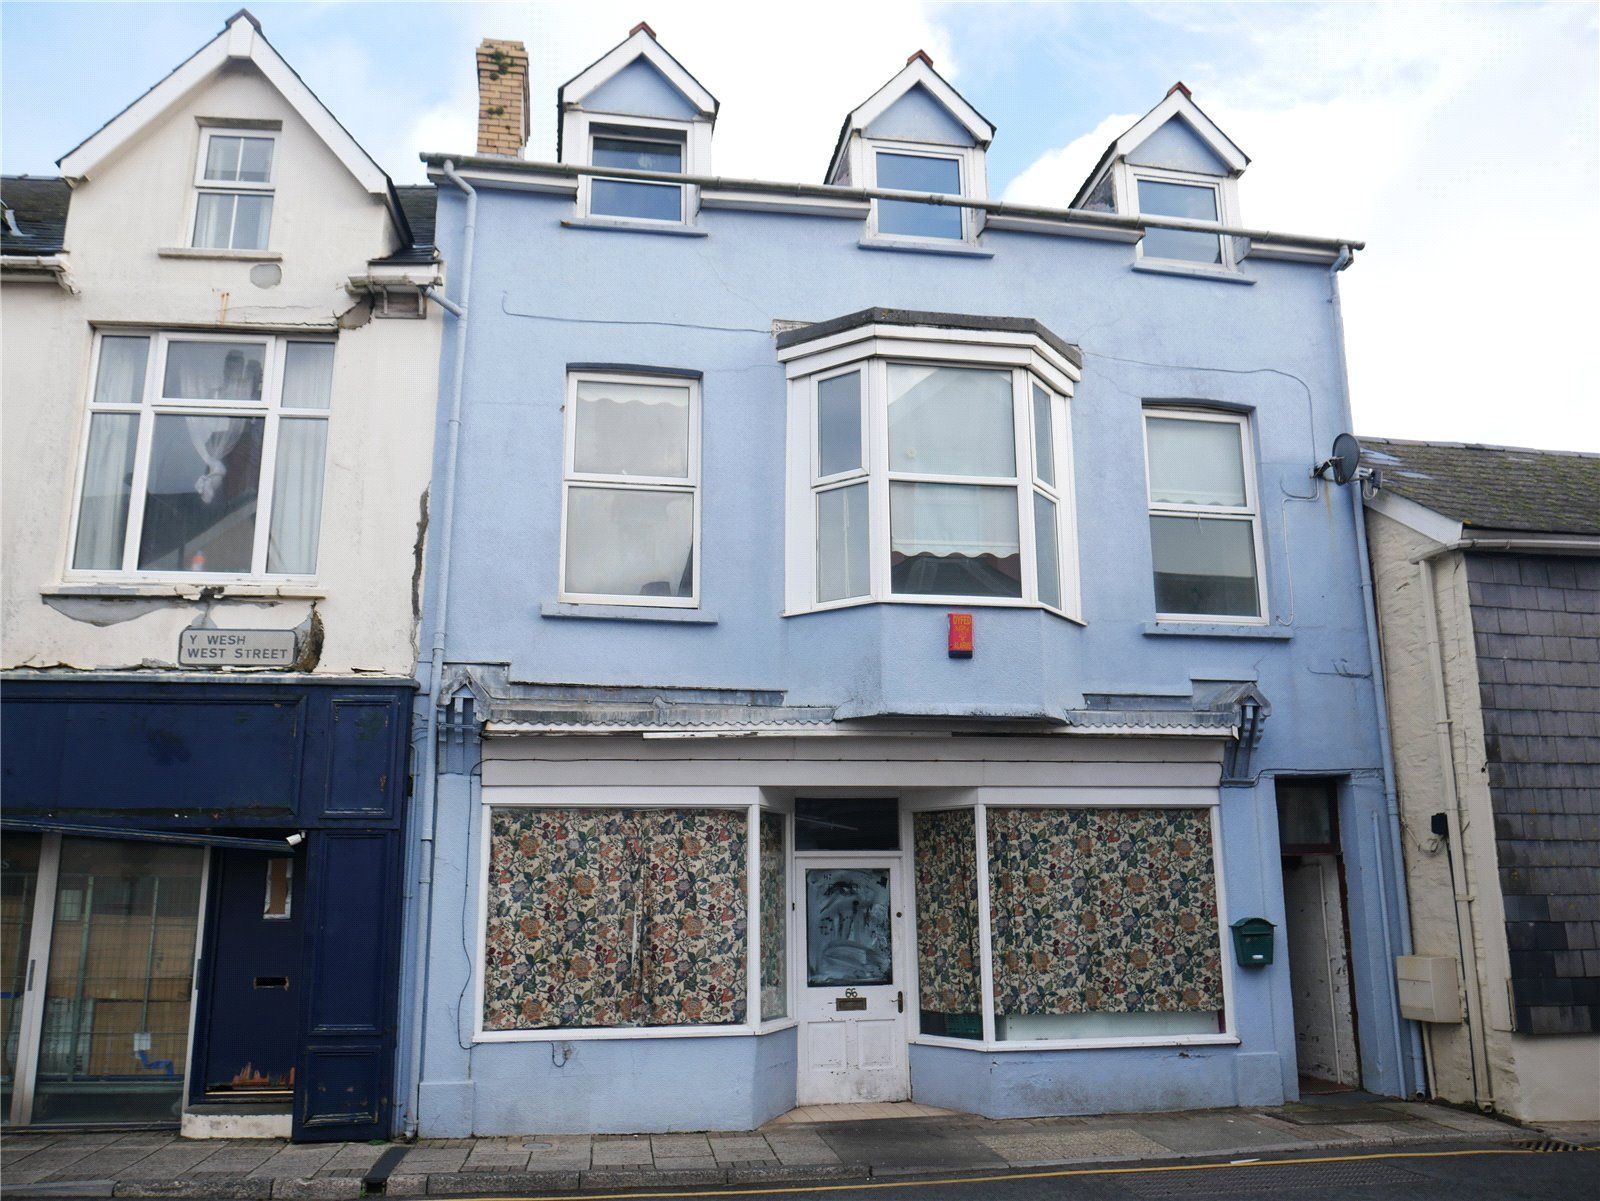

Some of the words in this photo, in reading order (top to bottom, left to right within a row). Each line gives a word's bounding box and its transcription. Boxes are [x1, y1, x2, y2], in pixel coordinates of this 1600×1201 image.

[953, 615, 972, 625] DYFED
[190, 635, 198, 645] Y
[207, 635, 246, 645] WESH
[187, 648, 226, 658] WEST
[234, 648, 288, 659] STREET
[845, 987, 858, 998] 66
